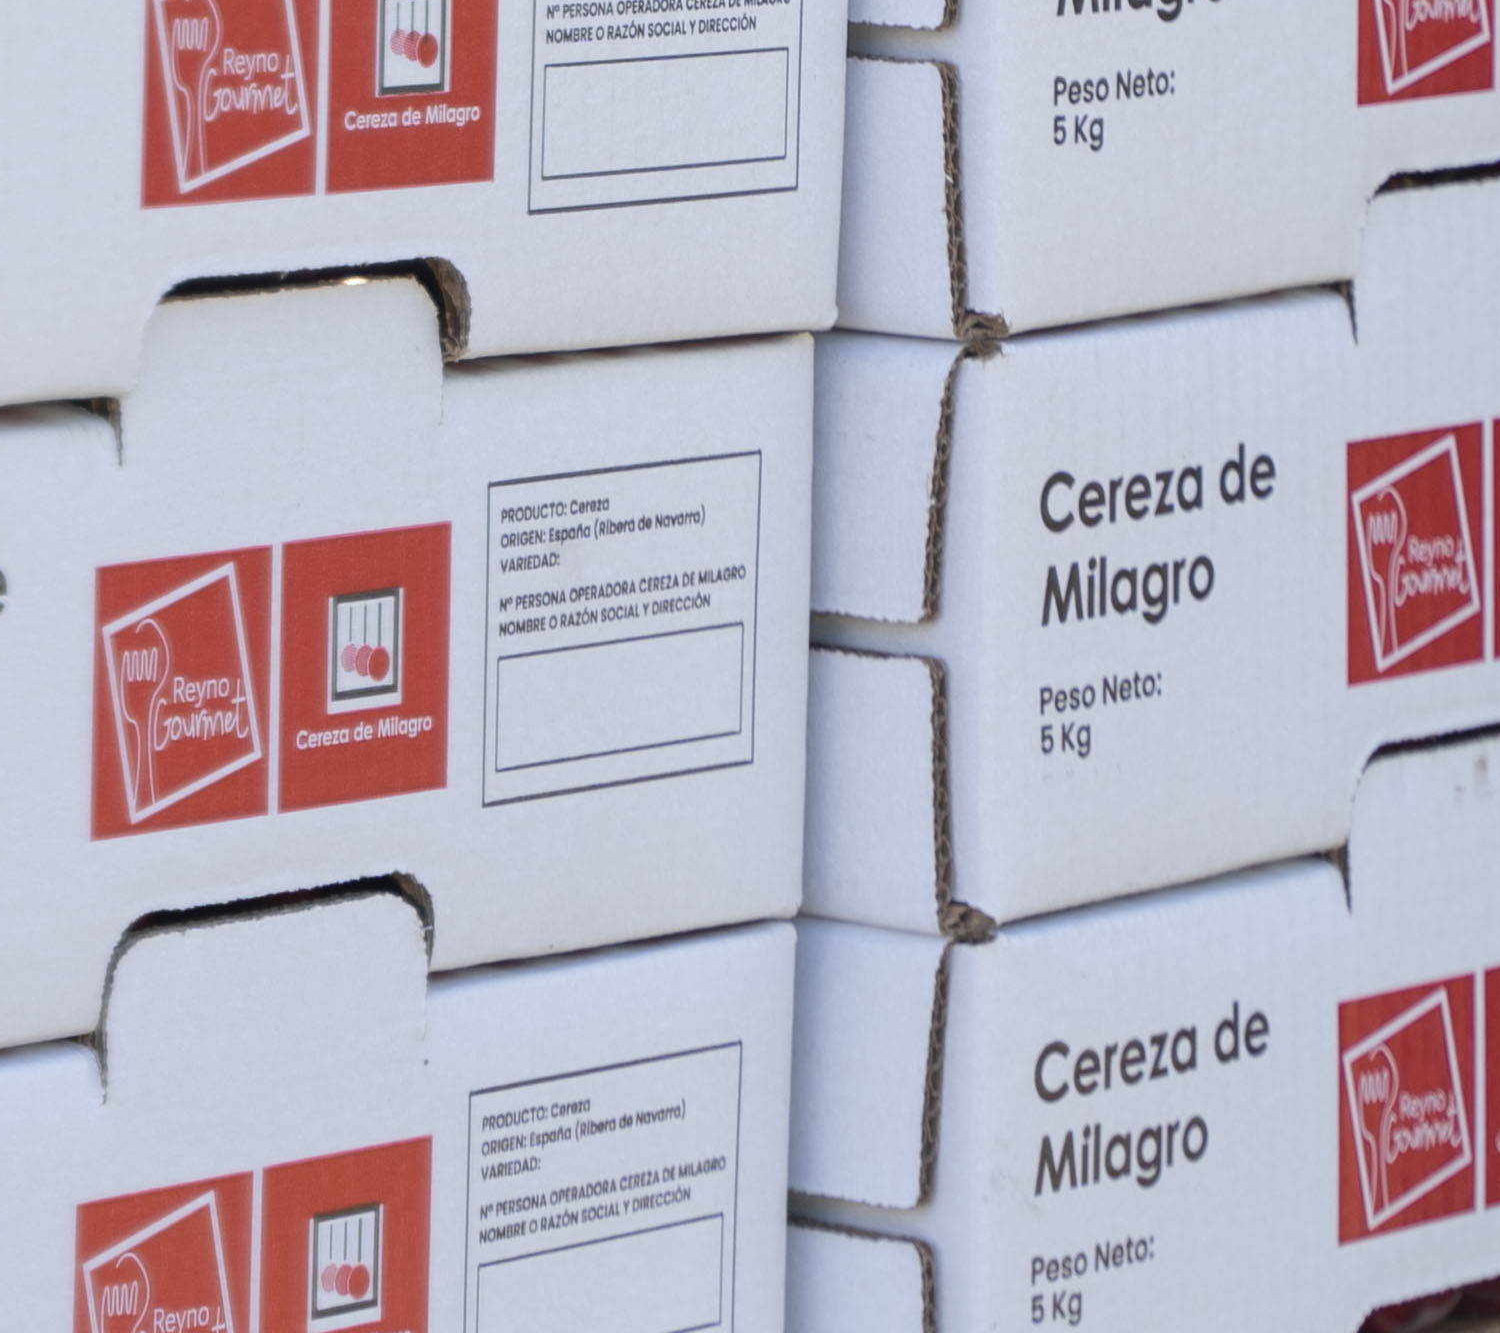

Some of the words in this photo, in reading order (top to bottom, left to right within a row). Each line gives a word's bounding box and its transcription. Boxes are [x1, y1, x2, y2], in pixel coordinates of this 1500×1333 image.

[546, 27, 593, 44] NOMBRE
[595, 26, 604, 40] O
[607, 20, 645, 40] RAZÓN
[647, 19, 686, 37] SOCIAL
[690, 20, 695, 34] Y
[699, 13, 757, 33] DIRECCIÓN
[547, 5, 560, 20] Nº
[223, 49, 279, 81] Reyno
[204, 55, 298, 122] Gourmet
[1054, 76, 1109, 106] Peso
[1117, 68, 1174, 100] Neto:
[344, 110, 398, 130] Cereza
[402, 107, 421, 125] de
[425, 104, 480, 127] Milagro
[1053, 115, 1066, 145] 5
[1074, 115, 1103, 151] Kg
[1040, 465, 1203, 533] Cereza
[1219, 443, 1276, 505] de
[500, 529, 546, 548] ORIGEN:
[549, 524, 591, 545] España
[594, 516, 635, 540] (Ribera
[638, 516, 651, 531] de
[655, 505, 705, 528] Navarra)
[501, 501, 567, 524] PRODUCTO:
[570, 498, 610, 515] Cereza
[500, 552, 560, 573] VARIEDAD:
[500, 597, 513, 613] Nº
[515, 589, 566, 610] PERSONA
[569, 580, 636, 603] OPERADORA
[639, 574, 679, 593] CEREZA
[682, 570, 695, 587] DE
[698, 565, 746, 584] MILAGRO
[1042, 555, 1214, 625] Milagro
[499, 617, 546, 637] NOMBRE
[549, 614, 558, 630] O
[560, 607, 597, 629] RAZÓN
[600, 603, 640, 624] SOCIAL
[643, 603, 649, 618] Y
[652, 592, 711, 616] DIRECCIÓN
[173, 677, 229, 707] Reyno
[1040, 684, 1095, 716] Peso
[1102, 671, 1162, 706] Neto:
[154, 679, 249, 751] Gourmet
[296, 724, 349, 749] Cereza
[354, 721, 373, 741] de
[378, 716, 432, 739] Milagro
[1041, 725, 1054, 755] 5
[1061, 722, 1091, 759] Kg
[1034, 1025, 1197, 1103] Cereza
[1214, 1000, 1269, 1064] de
[481, 1135, 527, 1156] ORIGEN:
[529, 1127, 571, 1149] España
[575, 1116, 616, 1142] (Ribera
[619, 1114, 633, 1129] de
[636, 1098, 686, 1126] Navarra)
[1034, 1115, 1208, 1197] Milagro
[1031, 1252, 1088, 1286] Peso
[1094, 1235, 1154, 1273] Neto:
[153, 1306, 209, 1333] Reyno
[1032, 1294, 1044, 1324] 5
[1052, 1291, 1082, 1327] Kg
